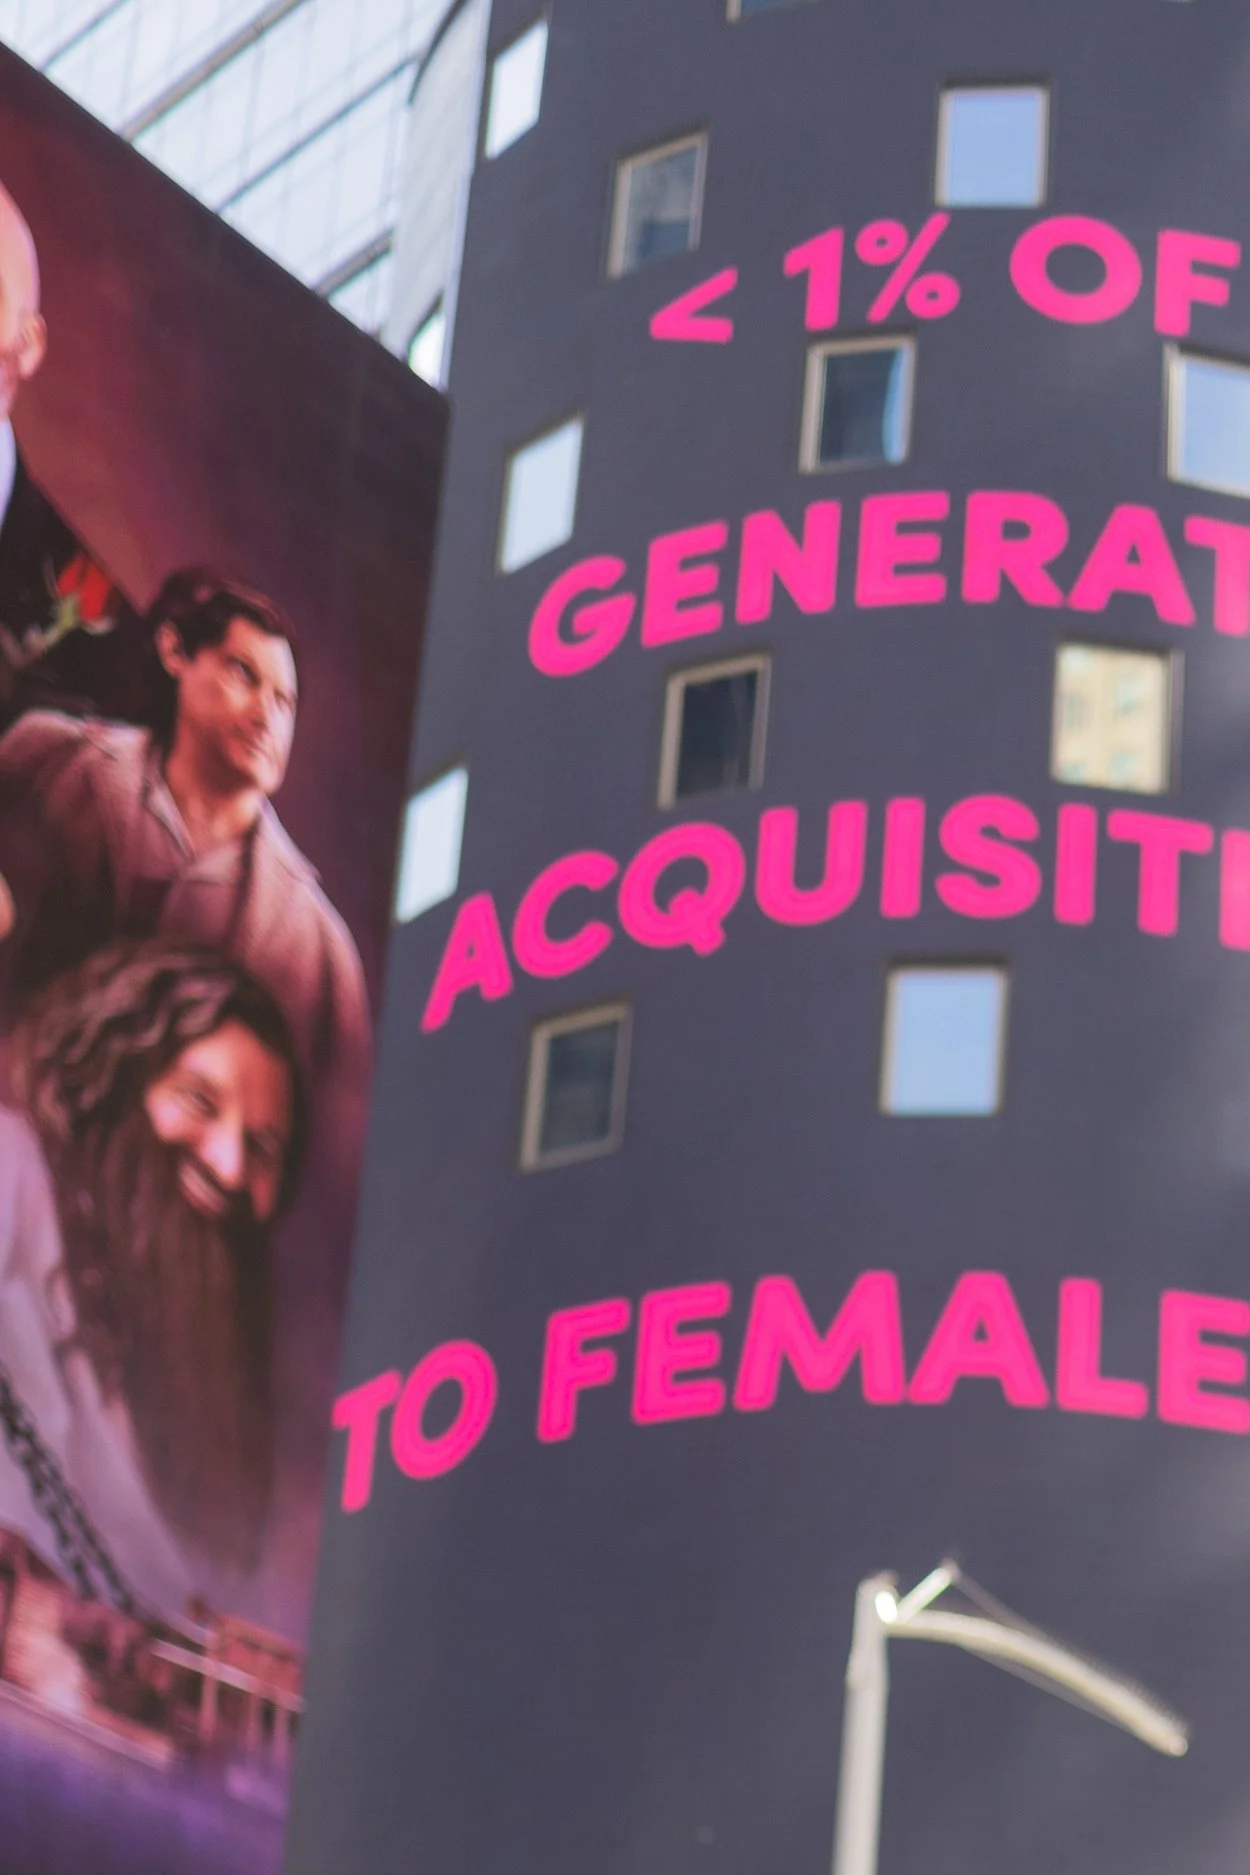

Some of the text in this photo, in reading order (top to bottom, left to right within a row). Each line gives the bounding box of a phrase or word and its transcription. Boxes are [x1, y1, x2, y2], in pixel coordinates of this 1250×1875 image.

[783, 212, 961, 331] 1%
[1009, 213, 1241, 337] OF
[330, 1338, 499, 1514] TO
